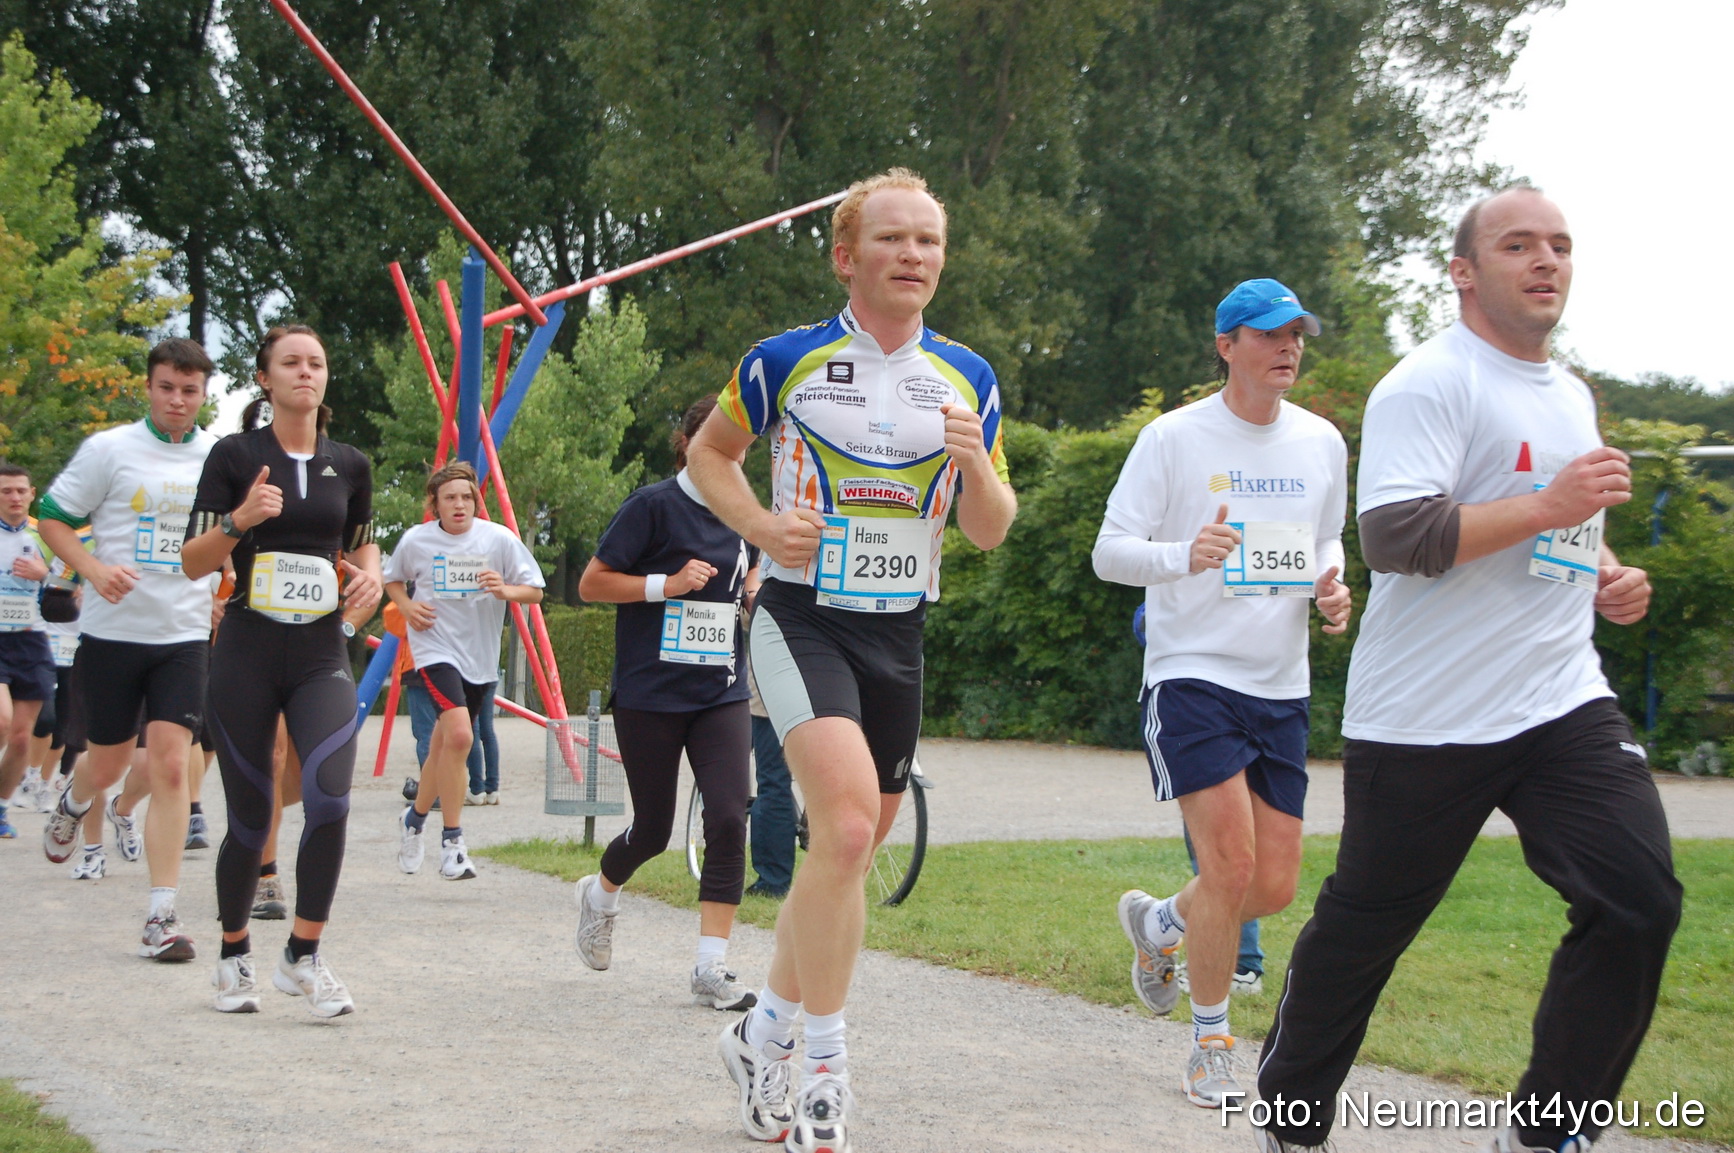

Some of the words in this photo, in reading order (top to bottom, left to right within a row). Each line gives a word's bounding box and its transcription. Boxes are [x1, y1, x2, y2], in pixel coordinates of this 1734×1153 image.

[795, 391, 866, 406] Fleischmann
[905, 385, 928, 395] Georg
[1228, 470, 1305, 493] HÄRTEIS
[855, 526, 889, 544] Hans
[277, 559, 321, 576] Stefanie
[827, 550, 834, 563] C
[853, 554, 917, 579] 2390
[1252, 550, 1306, 570] 3546
[283, 582, 323, 602] 240
[2, 609, 31, 620] 3223
[686, 607, 716, 620] Monika
[685, 625, 727, 643] 3036
